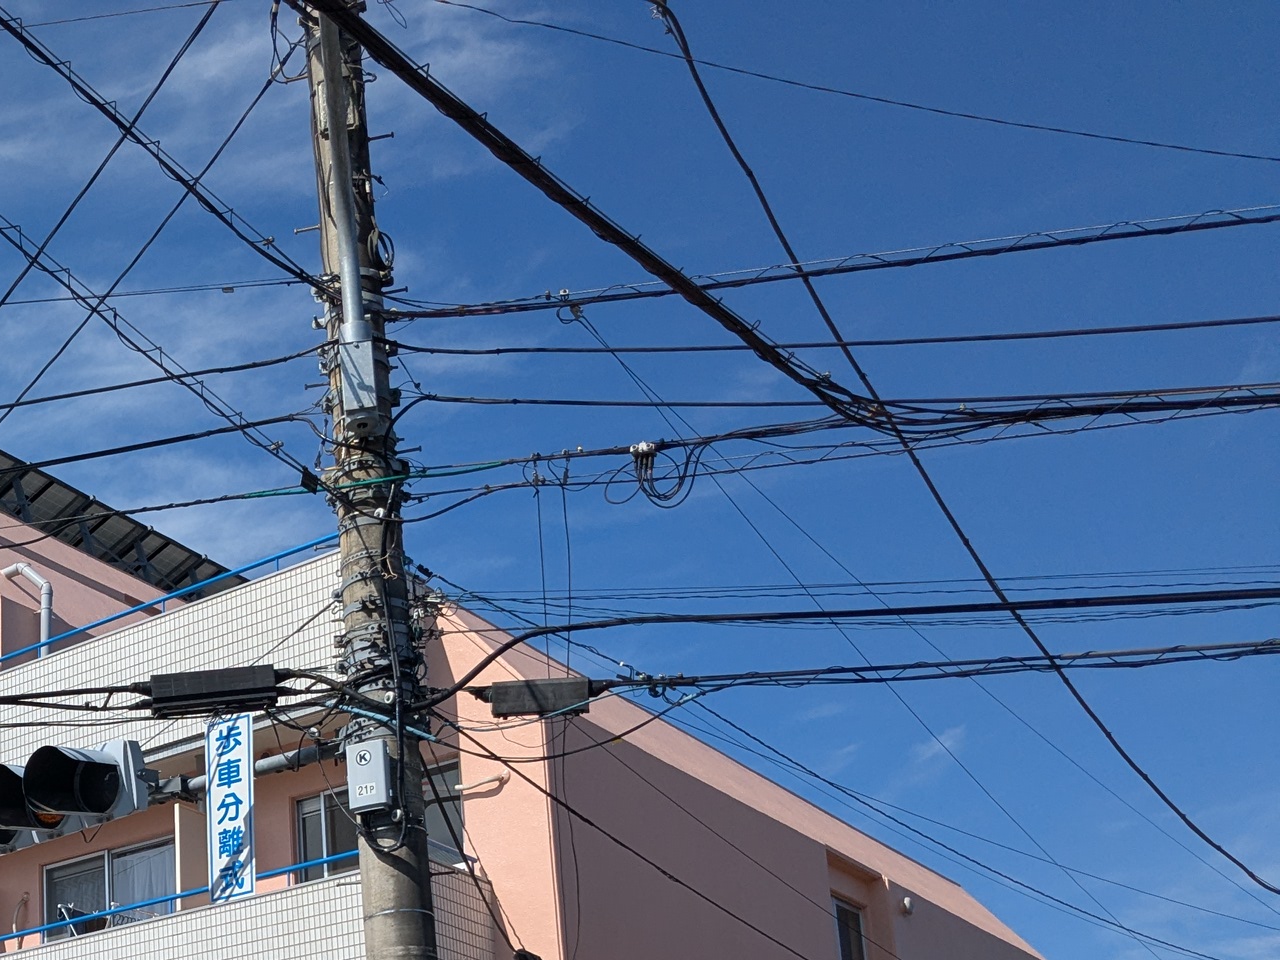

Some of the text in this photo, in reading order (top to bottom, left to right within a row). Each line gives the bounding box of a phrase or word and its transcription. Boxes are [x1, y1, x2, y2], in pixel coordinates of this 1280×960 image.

[215, 725, 244, 892] 歩車分離式
[358, 785, 375, 796] 21P
